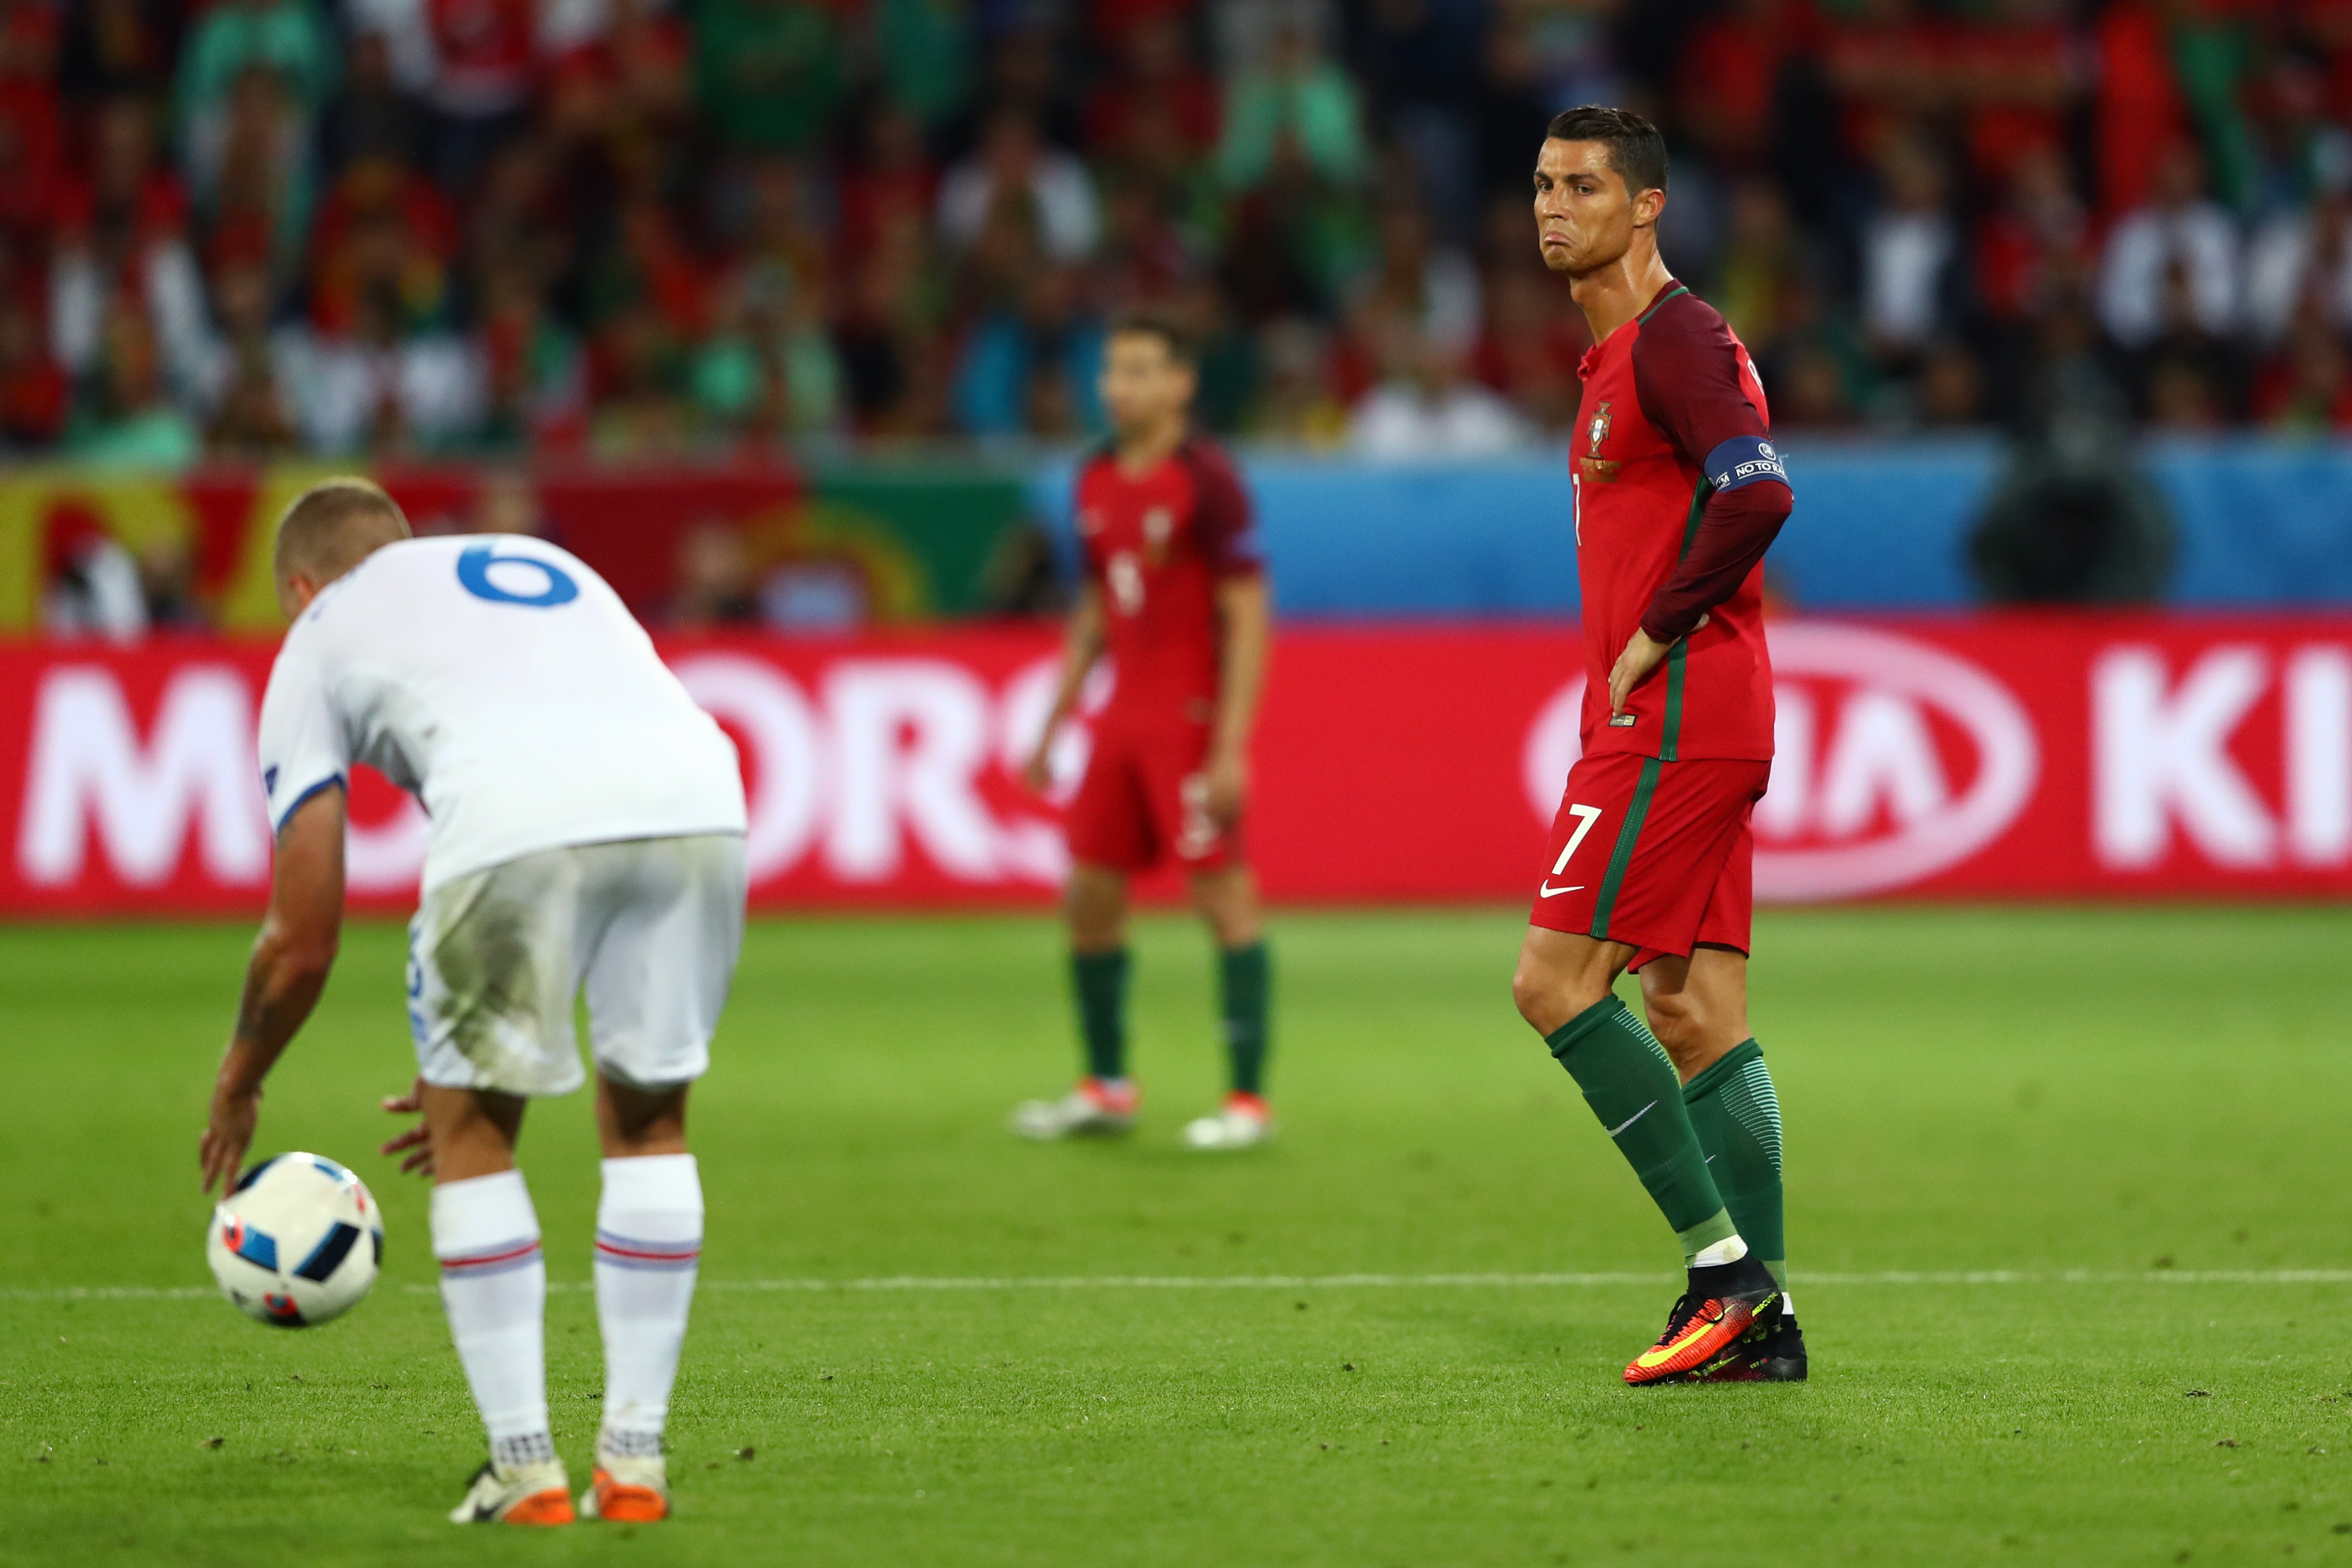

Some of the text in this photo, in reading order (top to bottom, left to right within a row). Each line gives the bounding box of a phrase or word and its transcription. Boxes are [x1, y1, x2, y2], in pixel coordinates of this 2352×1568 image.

[1736, 465, 1754, 476] NO
[1755, 463, 1771, 471] TO
[457, 540, 579, 607] 6
[17, 655, 1115, 889] MORS
[1551, 803, 1603, 876] 7
